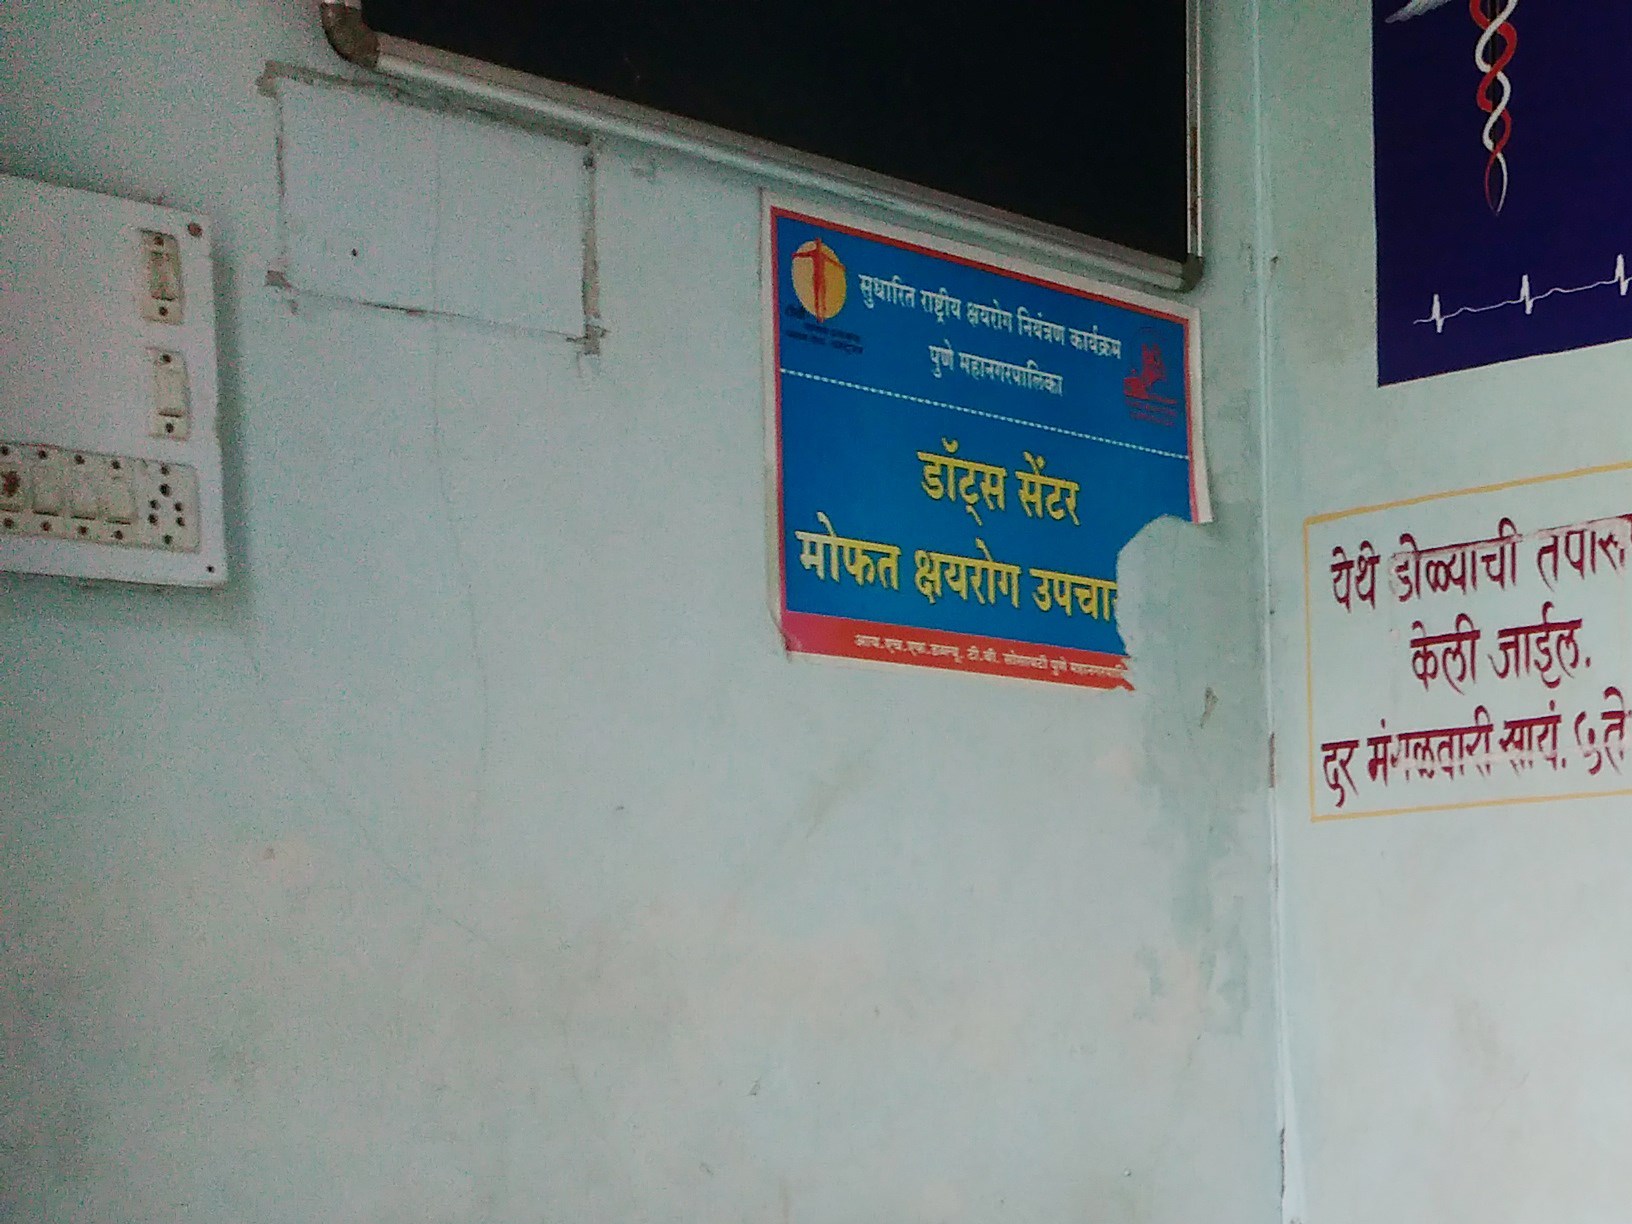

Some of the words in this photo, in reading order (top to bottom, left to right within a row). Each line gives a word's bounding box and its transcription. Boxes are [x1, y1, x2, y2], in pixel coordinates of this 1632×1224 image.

[858, 273, 916, 309] सुधारित
[920, 287, 962, 324] राष्ट्रीय
[967, 299, 1013, 333] क्षयरोग
[1017, 306, 1065, 346] नियंत्रण
[1069, 325, 1122, 360] कार्यक्रम
[928, 339, 954, 378] पुणे
[958, 351, 1064, 396] महानगरपालिका
[917, 437, 1007, 527] डॉट्स
[1015, 451, 1080, 527] सेंटर
[795, 511, 901, 590] मोफत
[914, 537, 1021, 609] क्षयरोग
[1029, 568, 1117, 622] उपचा
[1331, 541, 1380, 613] येथे
[1410, 612, 1481, 696] केली
